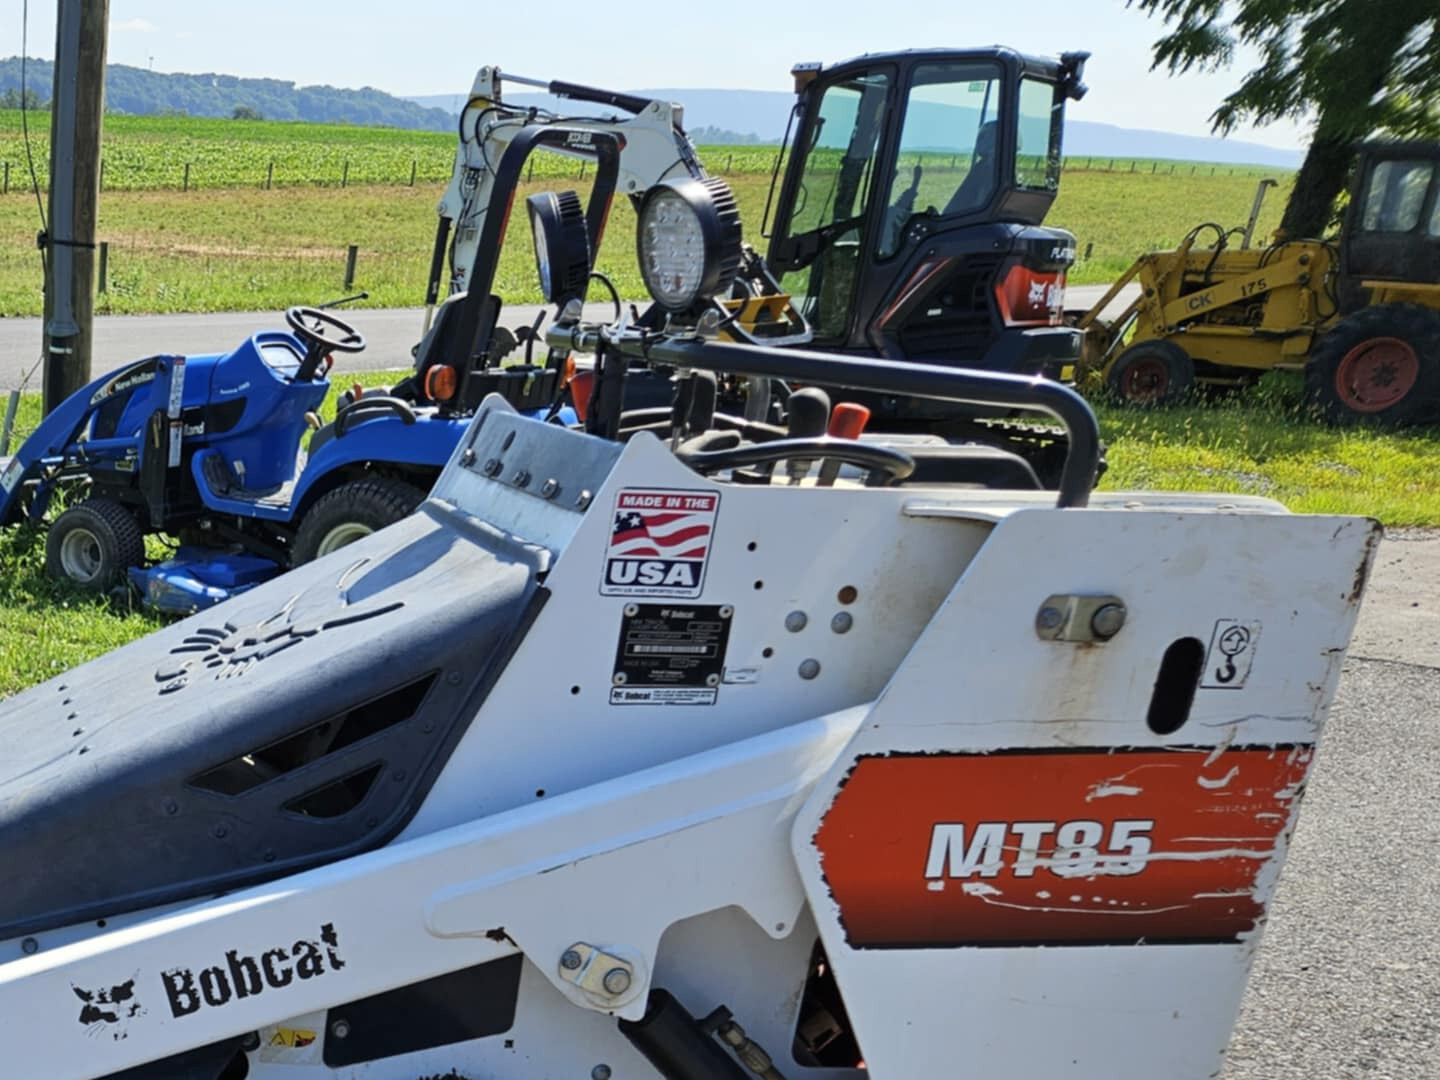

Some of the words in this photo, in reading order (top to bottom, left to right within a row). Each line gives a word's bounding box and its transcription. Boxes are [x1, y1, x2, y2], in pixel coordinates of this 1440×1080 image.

[131, 372, 156, 384] Hollan
[622, 495, 664, 507] MADE
[666, 496, 682, 508] IN
[685, 498, 711, 509] THE
[609, 561, 695, 586] USA
[924, 819, 1155, 879] MT85
[161, 922, 345, 1019] Bobcat
